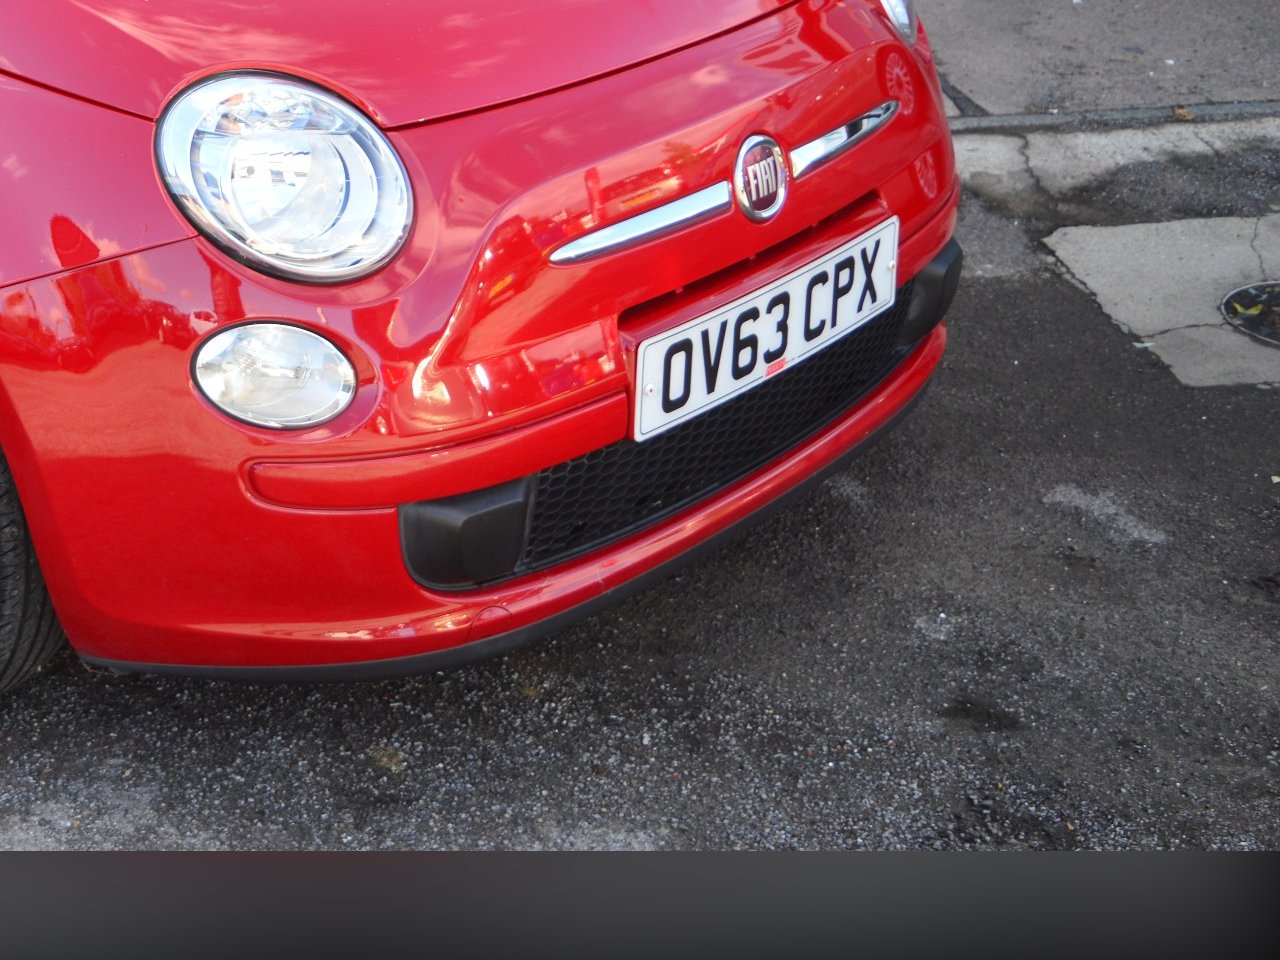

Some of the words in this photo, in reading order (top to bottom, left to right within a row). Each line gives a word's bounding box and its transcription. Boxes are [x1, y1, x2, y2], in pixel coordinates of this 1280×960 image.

[746, 156, 779, 202] FIAT
[661, 291, 790, 414] OV63
[803, 238, 881, 343] CPX
